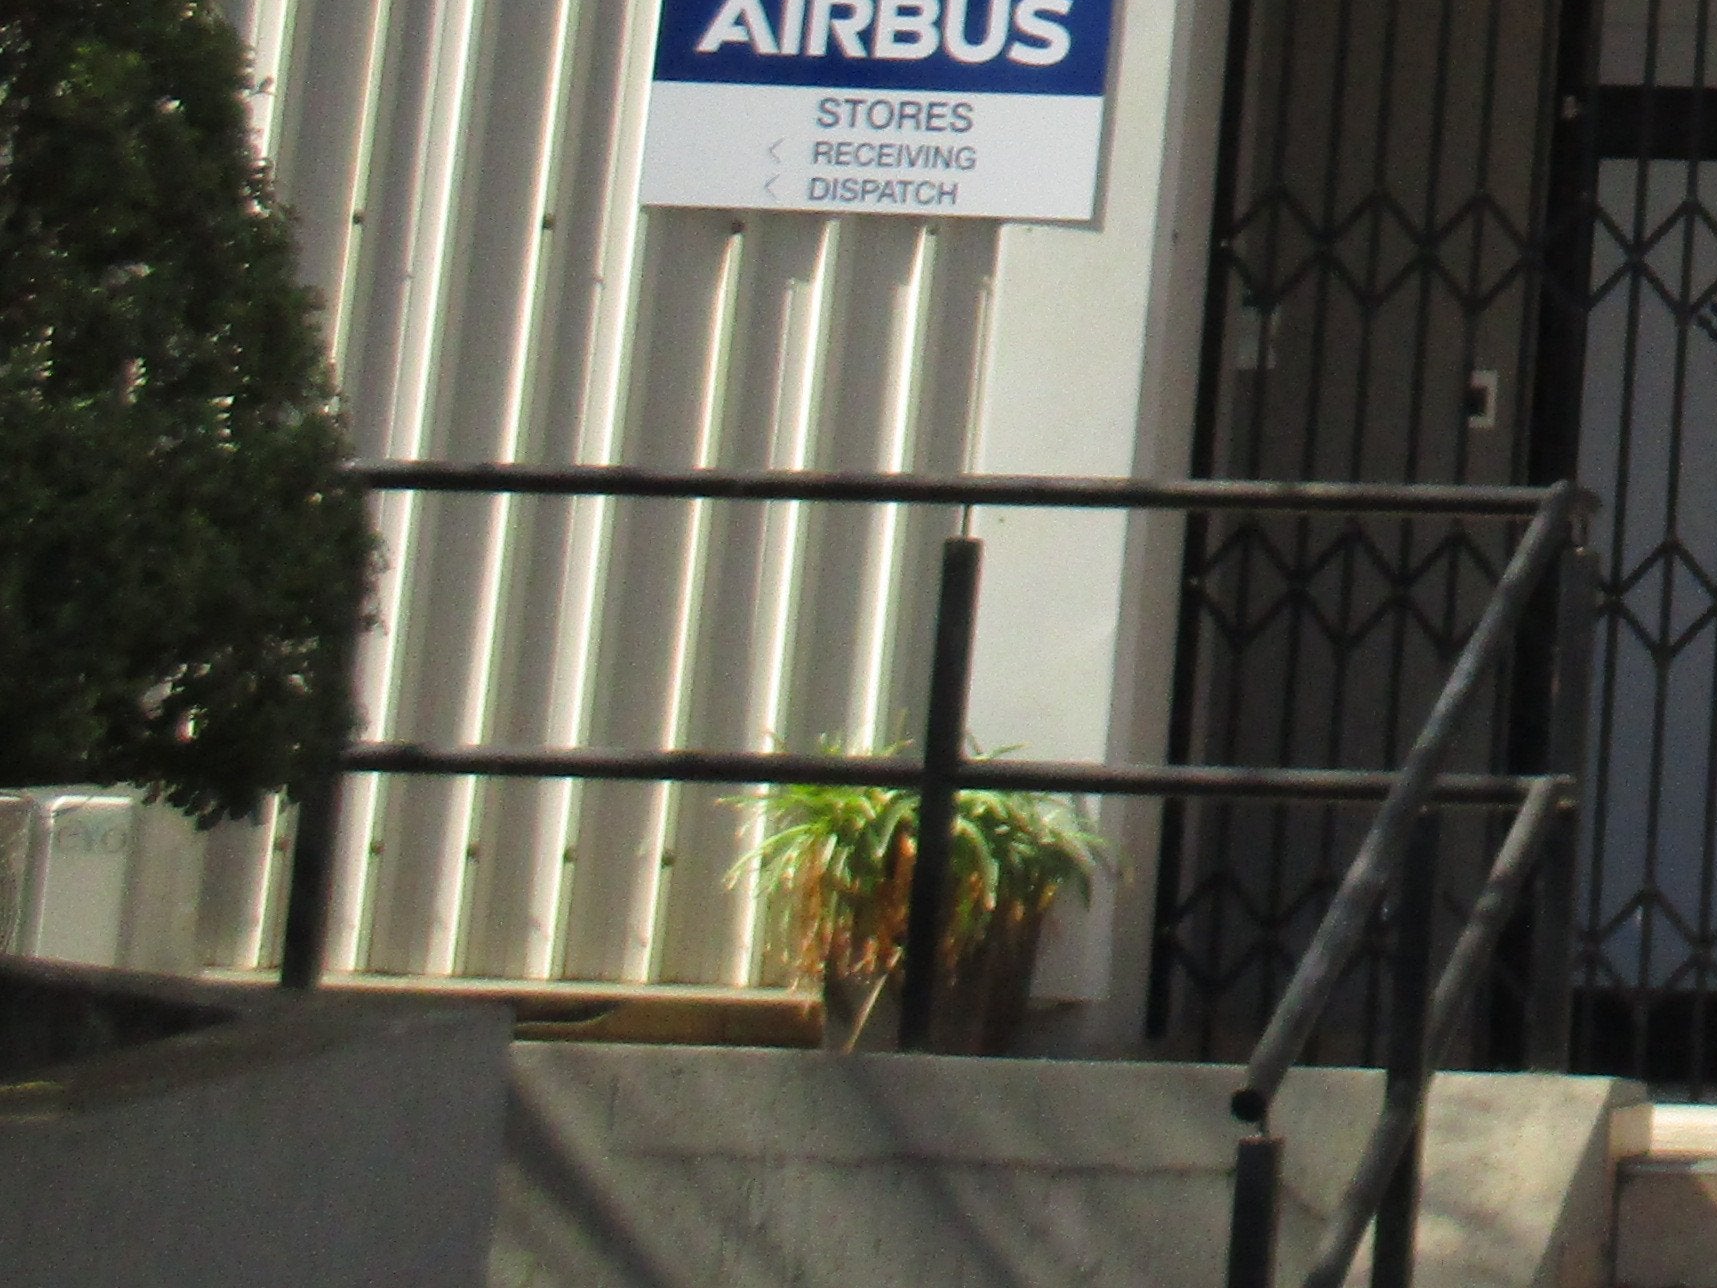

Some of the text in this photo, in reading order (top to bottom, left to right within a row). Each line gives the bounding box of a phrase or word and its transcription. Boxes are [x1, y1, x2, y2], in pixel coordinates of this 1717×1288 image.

[816, 97, 974, 132] STORES
[810, 140, 977, 171] RECEIVING
[807, 177, 958, 205] DISPATCH
